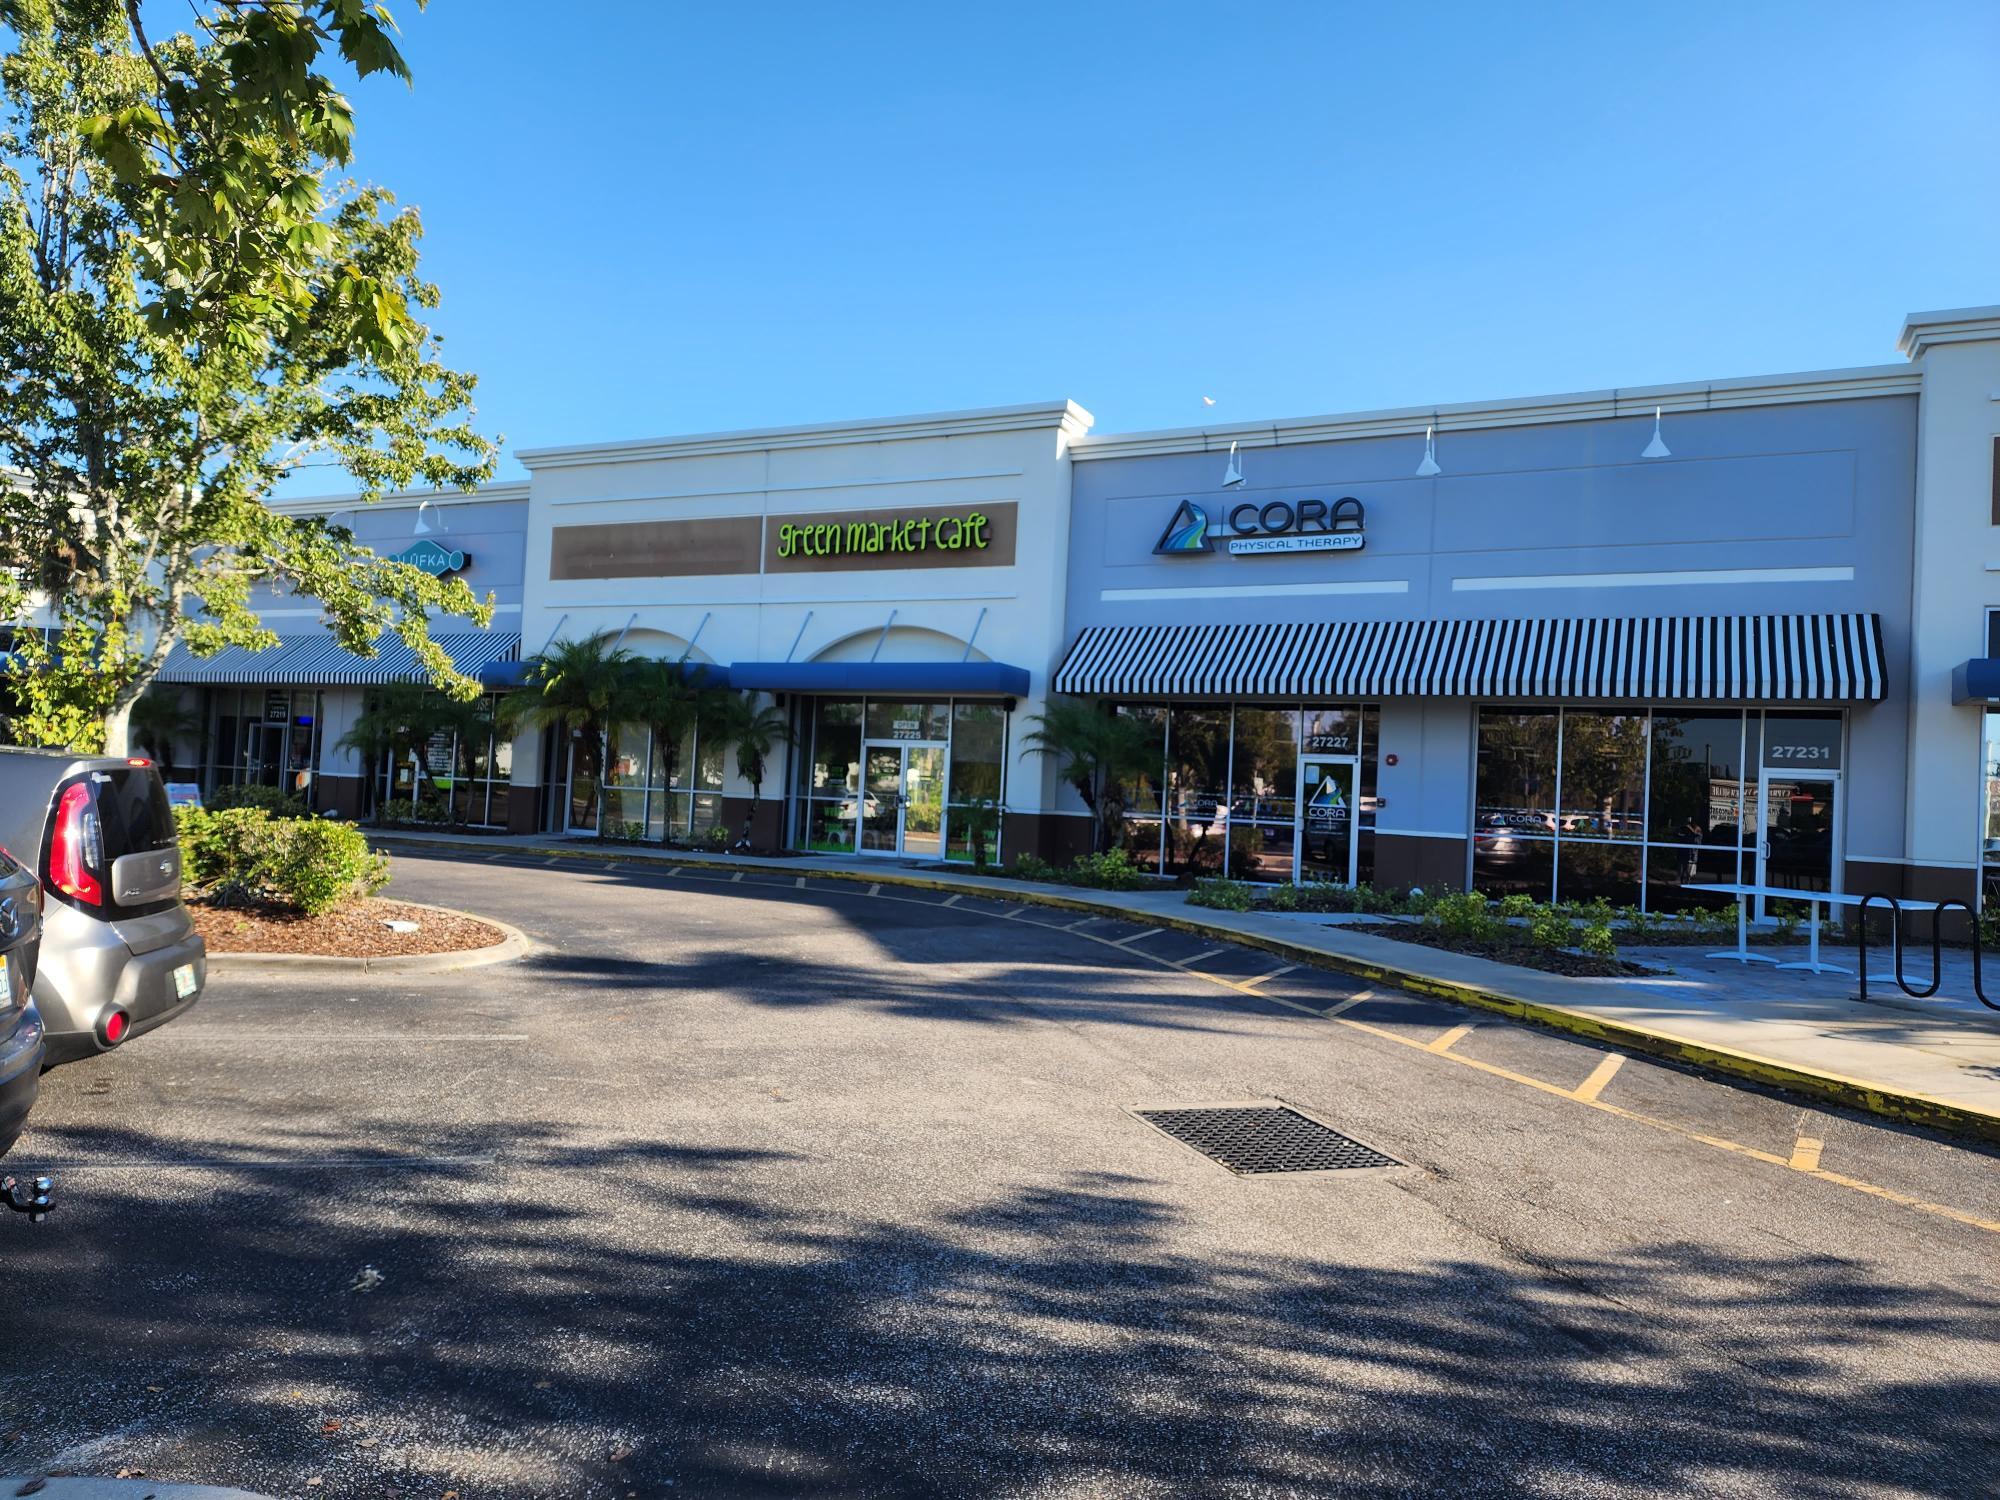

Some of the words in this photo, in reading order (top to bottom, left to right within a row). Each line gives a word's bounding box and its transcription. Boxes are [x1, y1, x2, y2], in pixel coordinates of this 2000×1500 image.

[1229, 496, 1365, 534] CORA
[777, 523, 842, 557] green
[846, 516, 932, 553] market
[1230, 540, 1293, 551] PHYSICAL
[1297, 537, 1361, 548] THERAPY
[892, 730, 921, 739] 27225
[1312, 736, 1349, 748] 27227
[1771, 746, 1830, 759] 27231
[1308, 807, 1345, 818] CORA
[1509, 814, 1542, 824] CORA
